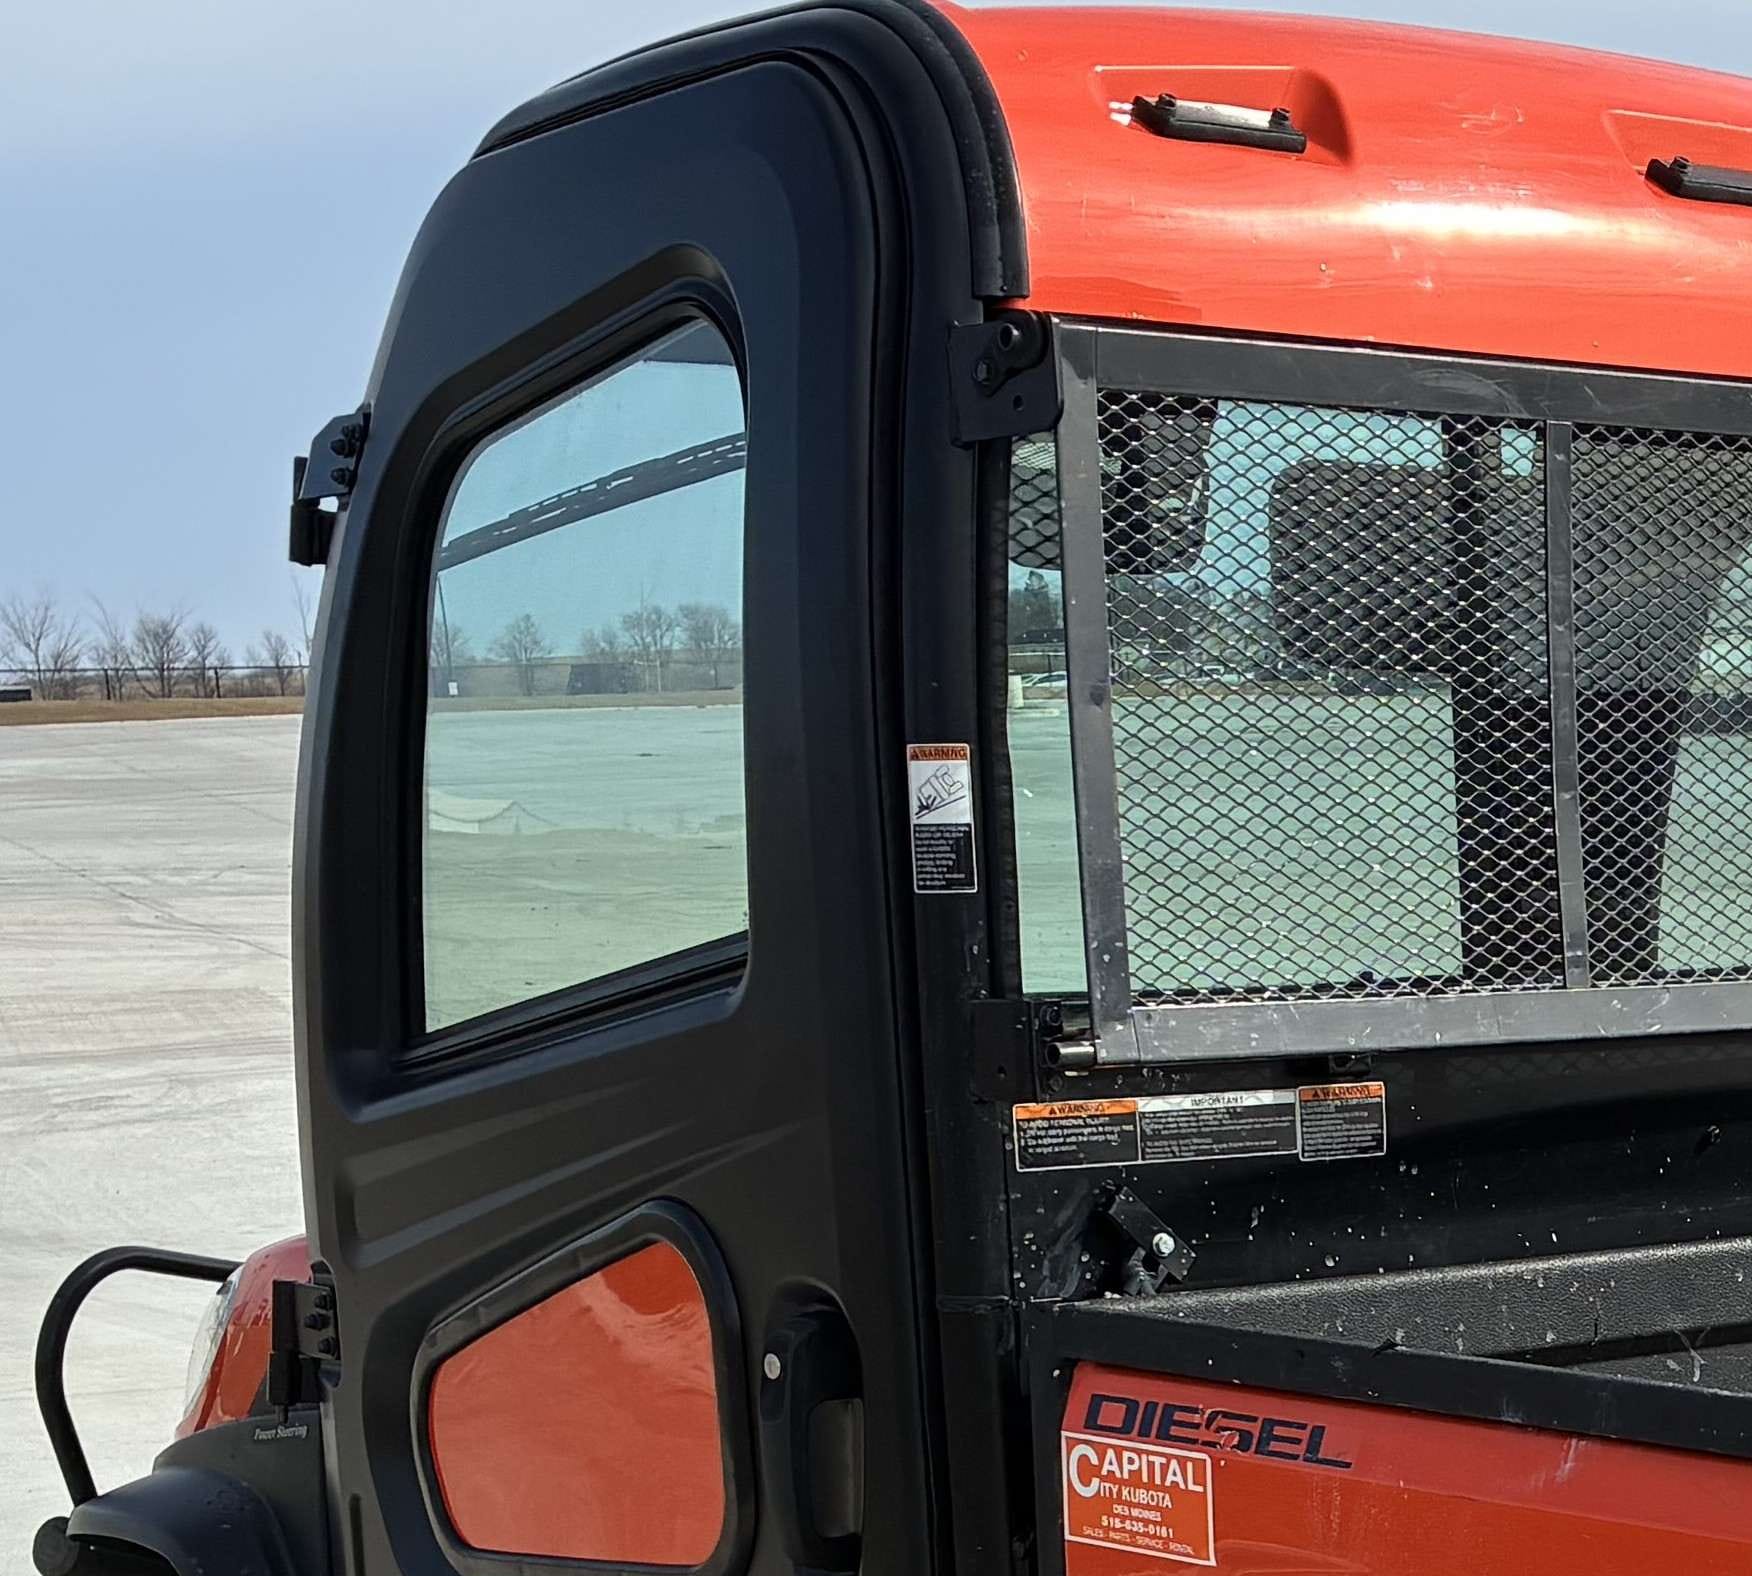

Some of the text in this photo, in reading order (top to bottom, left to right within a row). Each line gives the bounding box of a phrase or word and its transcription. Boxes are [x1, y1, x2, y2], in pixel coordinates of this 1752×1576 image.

[918, 748, 967, 760] WARNING
[1191, 1095, 1244, 1107] IMPORTANT
[1083, 1394, 1352, 1469] DIESEL
[1069, 1444, 1204, 1498] CAPITAL
[1121, 1485, 1173, 1509] KUBOTA
